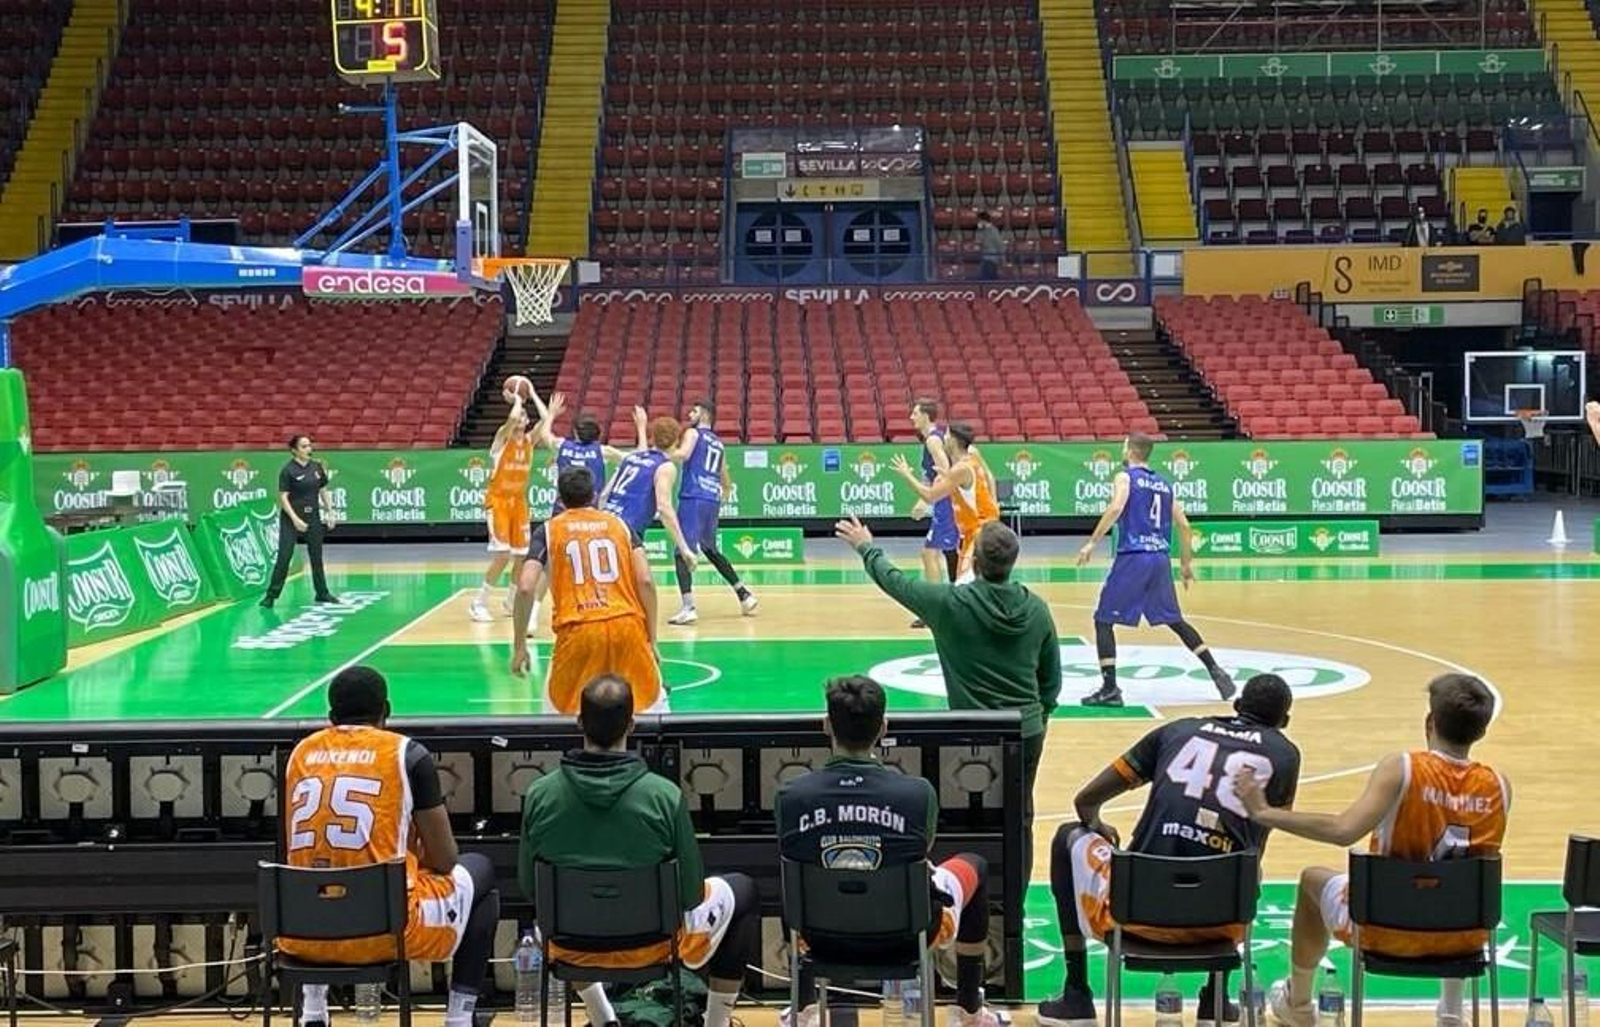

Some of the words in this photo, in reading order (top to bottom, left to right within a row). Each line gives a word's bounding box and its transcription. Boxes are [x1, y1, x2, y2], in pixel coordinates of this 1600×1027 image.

[382, 21, 407, 62] 5
[797, 158, 858, 172] SEVILLA
[1368, 255, 1402, 272] IMD
[317, 273, 428, 297] endesa
[613, 464, 640, 496] 12
[1149, 493, 1161, 528] 4
[565, 538, 619, 585] 10
[1166, 735, 1273, 819] 48
[291, 776, 382, 851] 25
[799, 807, 832, 832] C.B.
[837, 804, 906, 834] MORÓN
[1162, 821, 1235, 854] maxoil
